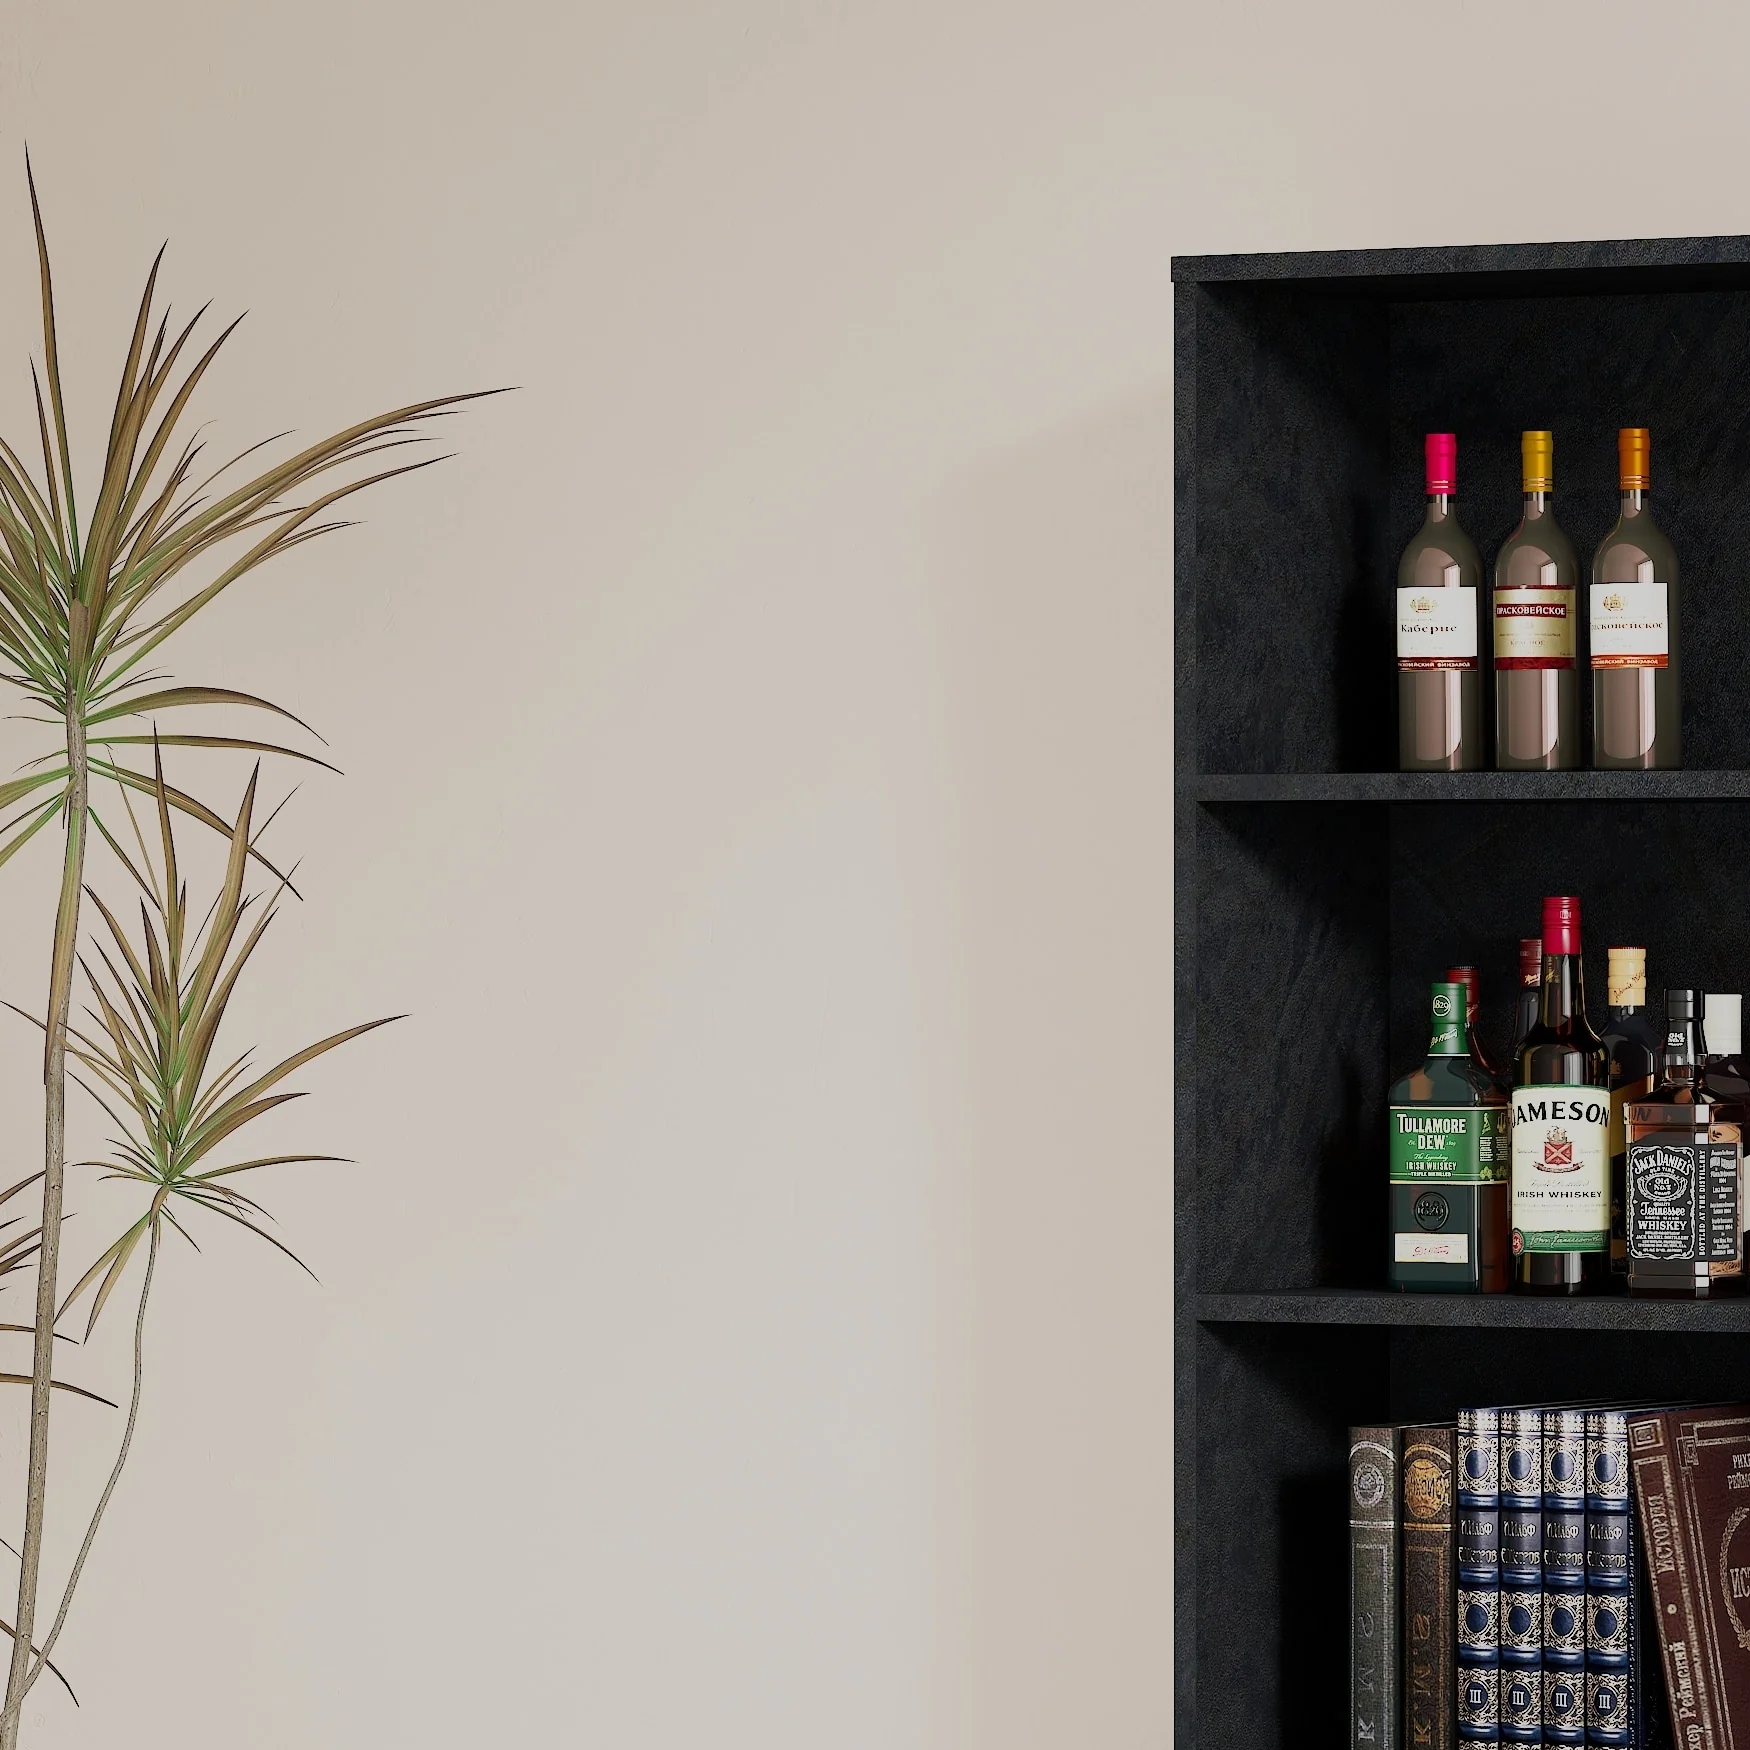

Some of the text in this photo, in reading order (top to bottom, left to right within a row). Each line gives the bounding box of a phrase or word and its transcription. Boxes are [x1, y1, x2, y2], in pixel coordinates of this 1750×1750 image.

[1496, 605, 1566, 616] ПРАСКОВЕЙСКОЕ
[1396, 1113, 1467, 1134] TULLAMORE
[1512, 1101, 1610, 1128] JAMESON
[1406, 1161, 1457, 1171] IRISH WHISKEY
[1633, 1154, 1657, 1175] JACK
[1640, 1201, 1686, 1216] Tennessee
[1698, 1150, 1706, 1256] BOTTLED AT THE DISTILLERY
[1637, 1220, 1688, 1231] WHISKEY
[1647, 1492, 1675, 1574] ИСТОРИЯ
